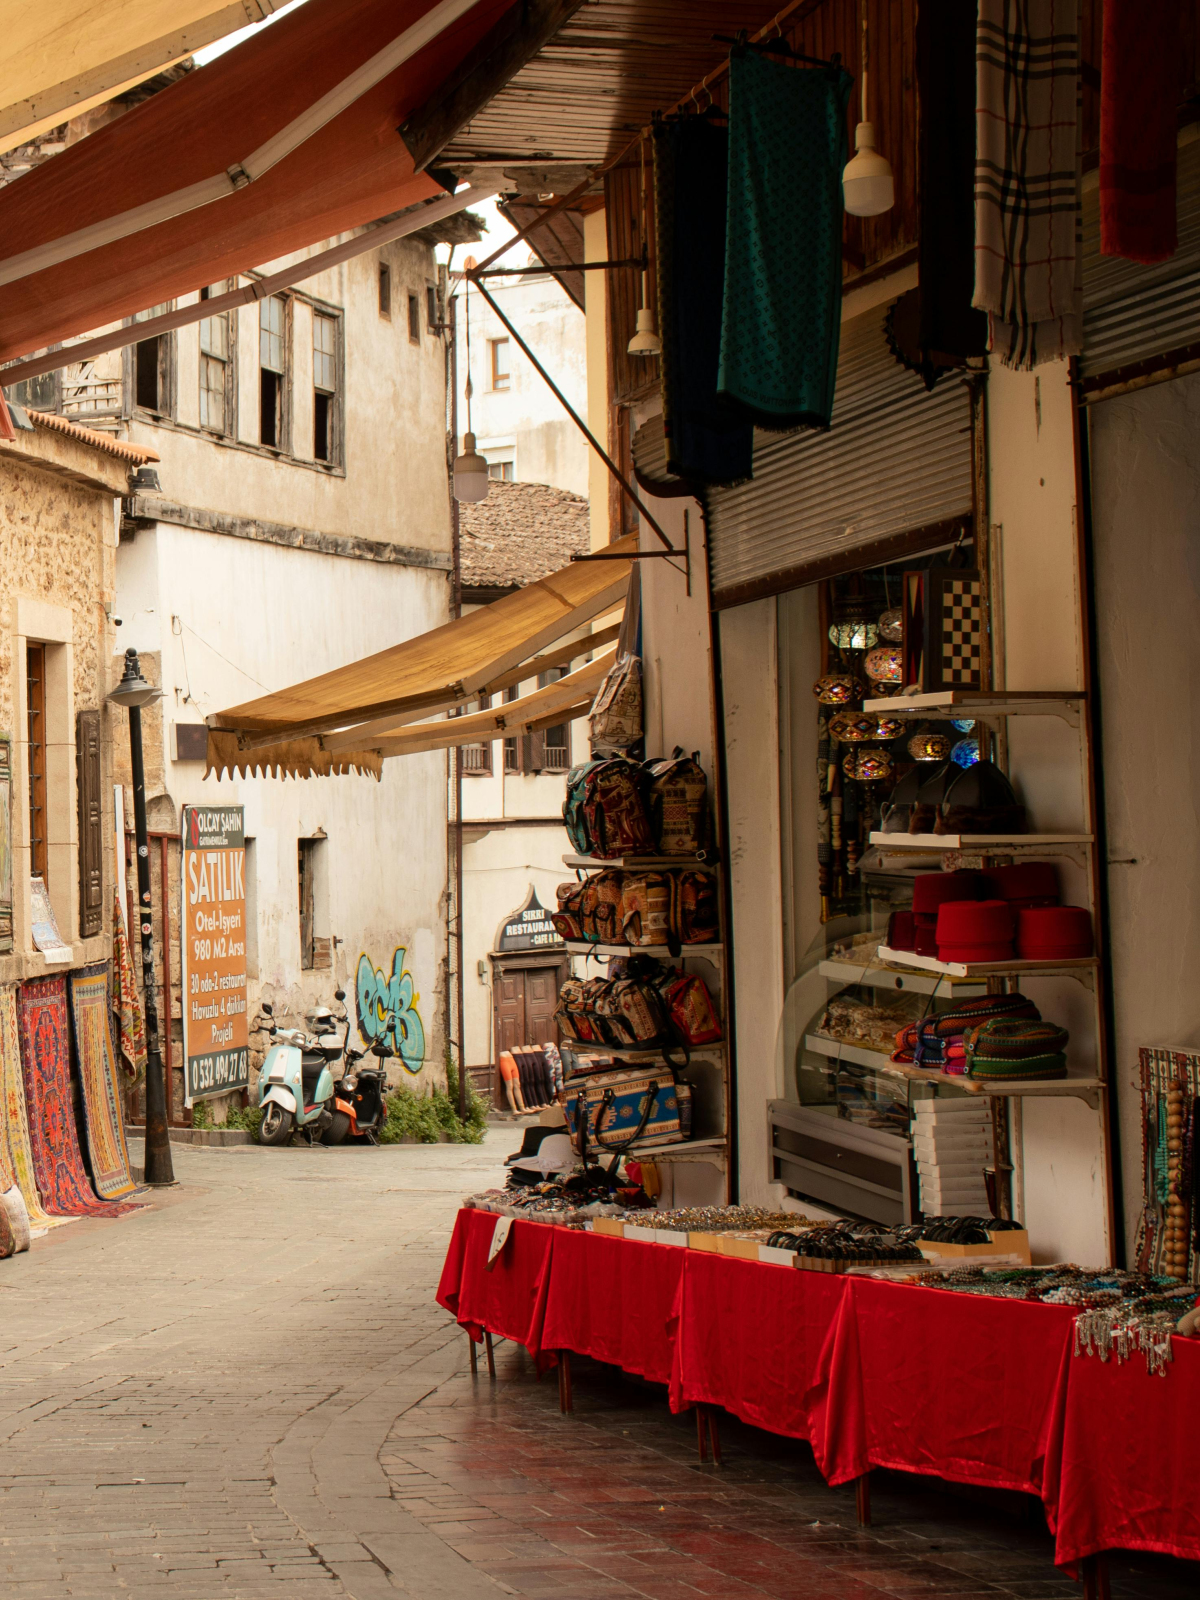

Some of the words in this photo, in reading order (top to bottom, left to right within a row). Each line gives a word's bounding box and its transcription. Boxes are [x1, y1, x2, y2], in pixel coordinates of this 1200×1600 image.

[189, 851, 245, 905] SATILIK
[195, 905, 241, 935] Otel-İşyeri
[506, 921, 556, 936] RESTAURAN
[194, 939, 211, 960] 980
[213, 938, 226, 958] M2
[228, 937, 244, 957] Arsa
[191, 974, 199, 994] 30
[192, 998, 219, 1021] Havuzlu
[220, 996, 225, 1016] 4
[211, 1022, 233, 1047] Projeli
[193, 1060, 198, 1090] 0
[199, 1057, 214, 1089] 532
[216, 1055, 228, 1084] 494
[229, 1053, 239, 1082] 27
[239, 1050, 247, 1080] 68
